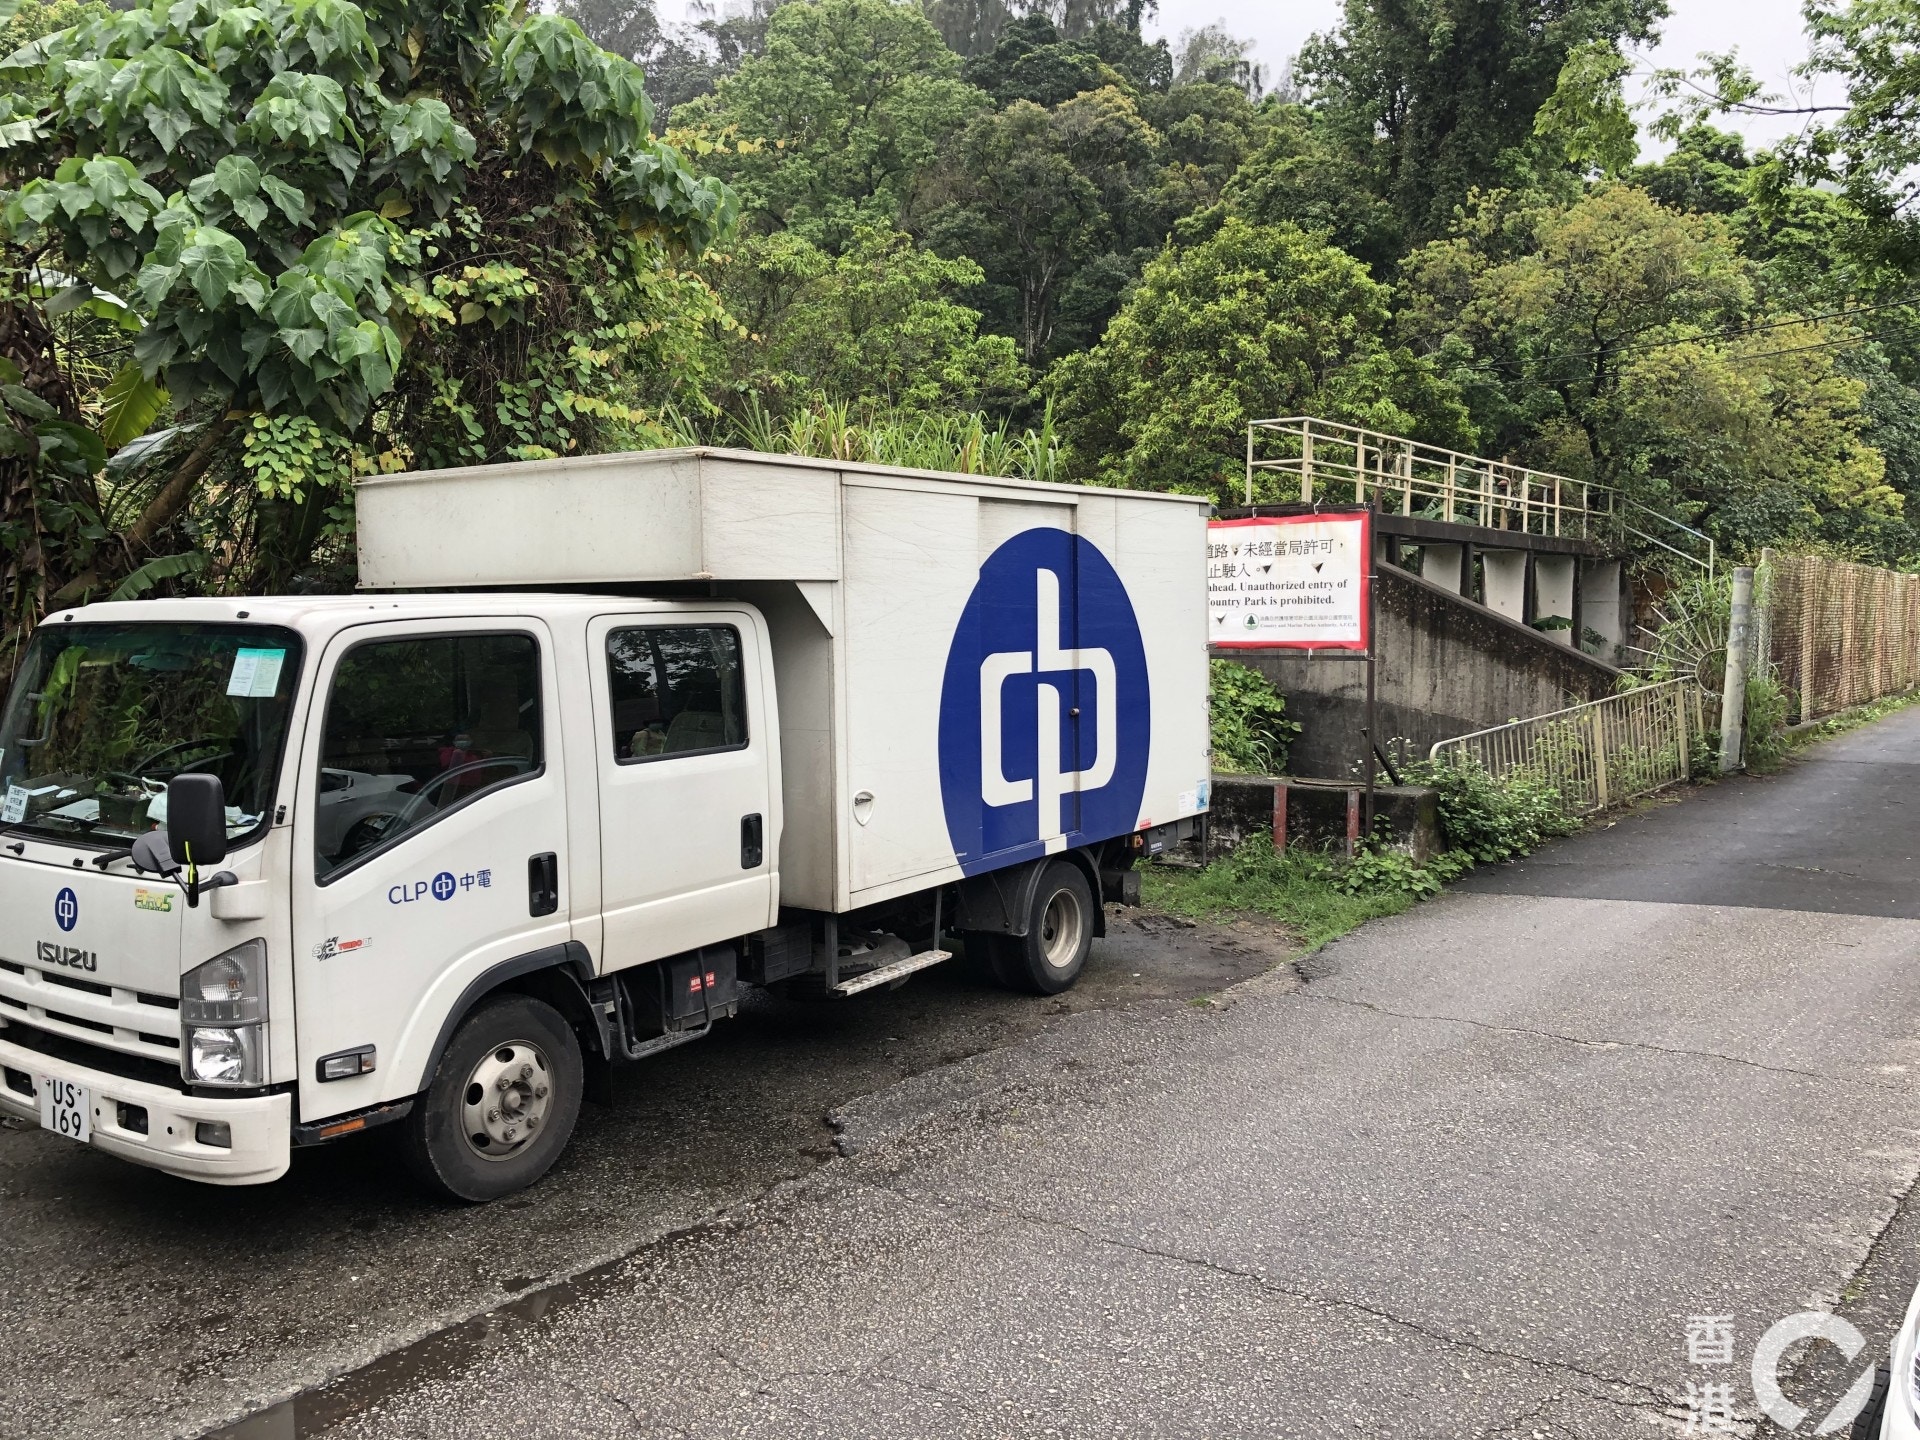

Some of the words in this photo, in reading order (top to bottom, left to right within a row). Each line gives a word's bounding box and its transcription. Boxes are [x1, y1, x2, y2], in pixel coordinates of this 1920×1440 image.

[1240, 580, 1305, 591] Unauthorized
[1308, 581, 1334, 591] entry
[1337, 579, 1348, 589] of
[1208, 597, 1240, 608] ountry
[1244, 596, 1267, 606] Park
[1269, 596, 1278, 605] is
[1280, 595, 1335, 607] prohibited.
[460, 869, 491, 892] 中電
[388, 881, 428, 904] CLP
[37, 940, 97, 972] ISUZU
[52, 1079, 75, 1108] US
[52, 1105, 82, 1136] 169
